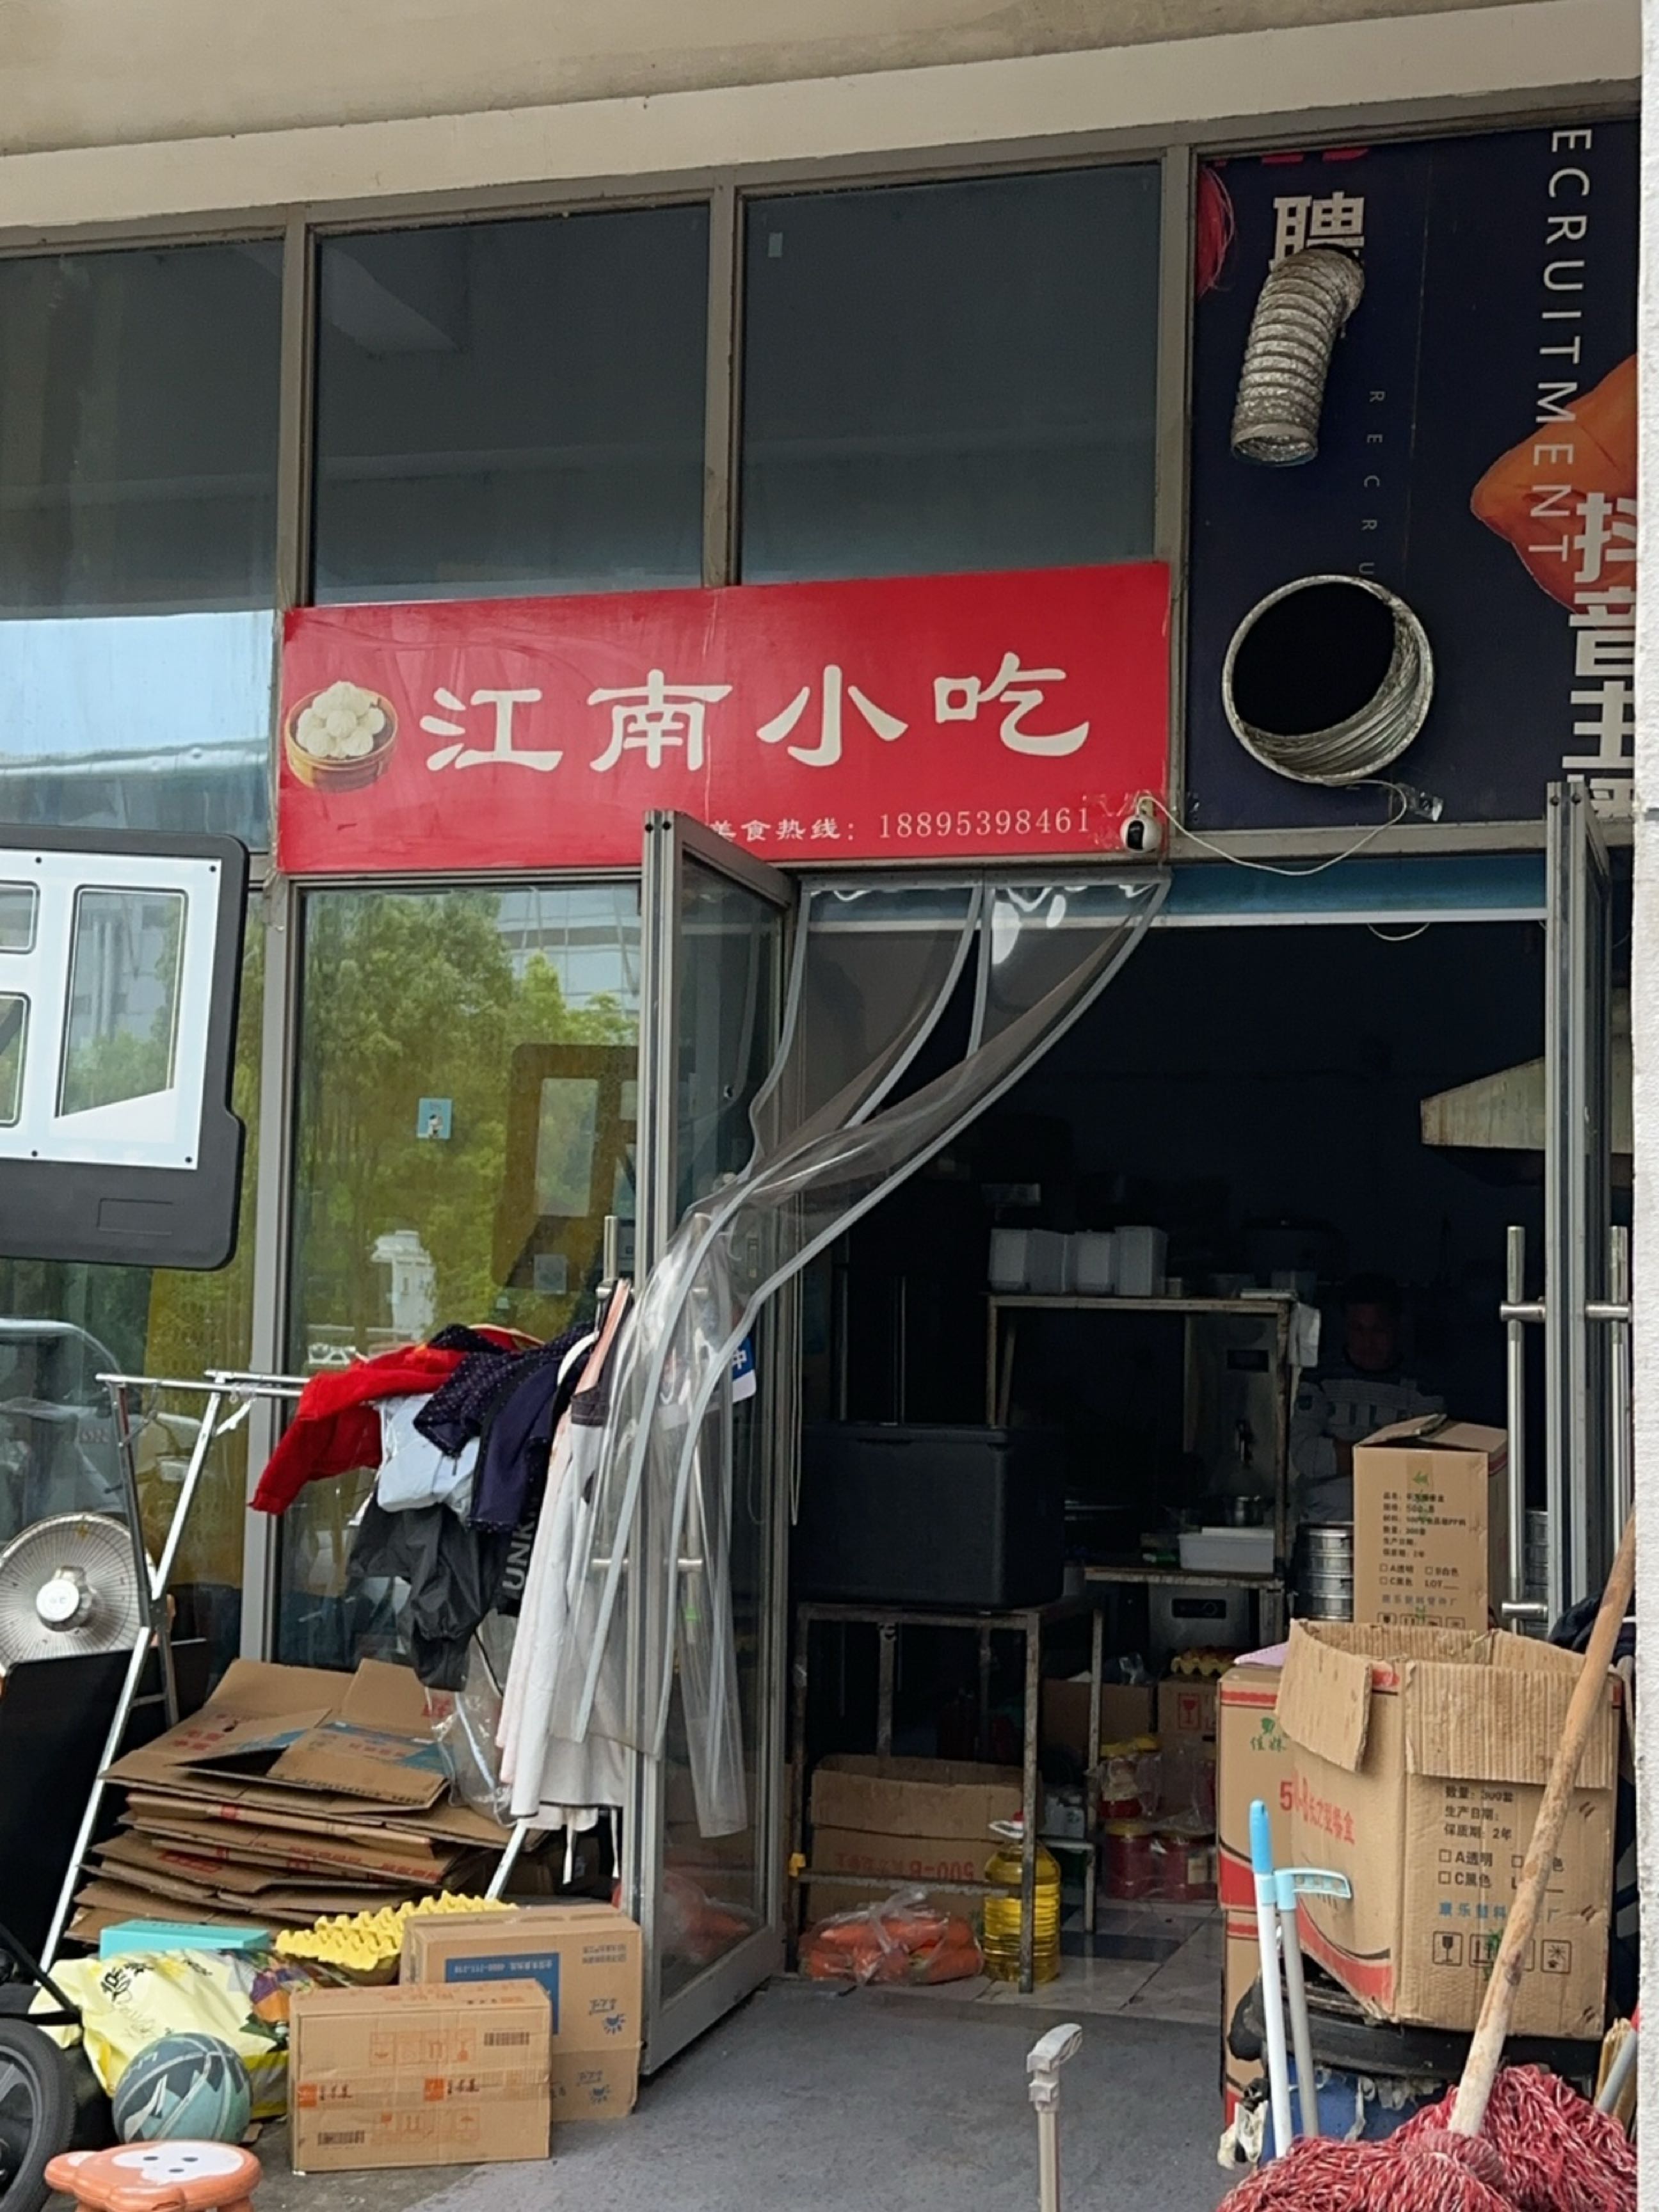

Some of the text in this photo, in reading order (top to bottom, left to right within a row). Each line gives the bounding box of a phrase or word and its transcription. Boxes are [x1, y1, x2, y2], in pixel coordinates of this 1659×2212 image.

[420, 652, 1089, 771] 江南小吃
[879, 808, 1089, 839] 18895398461
